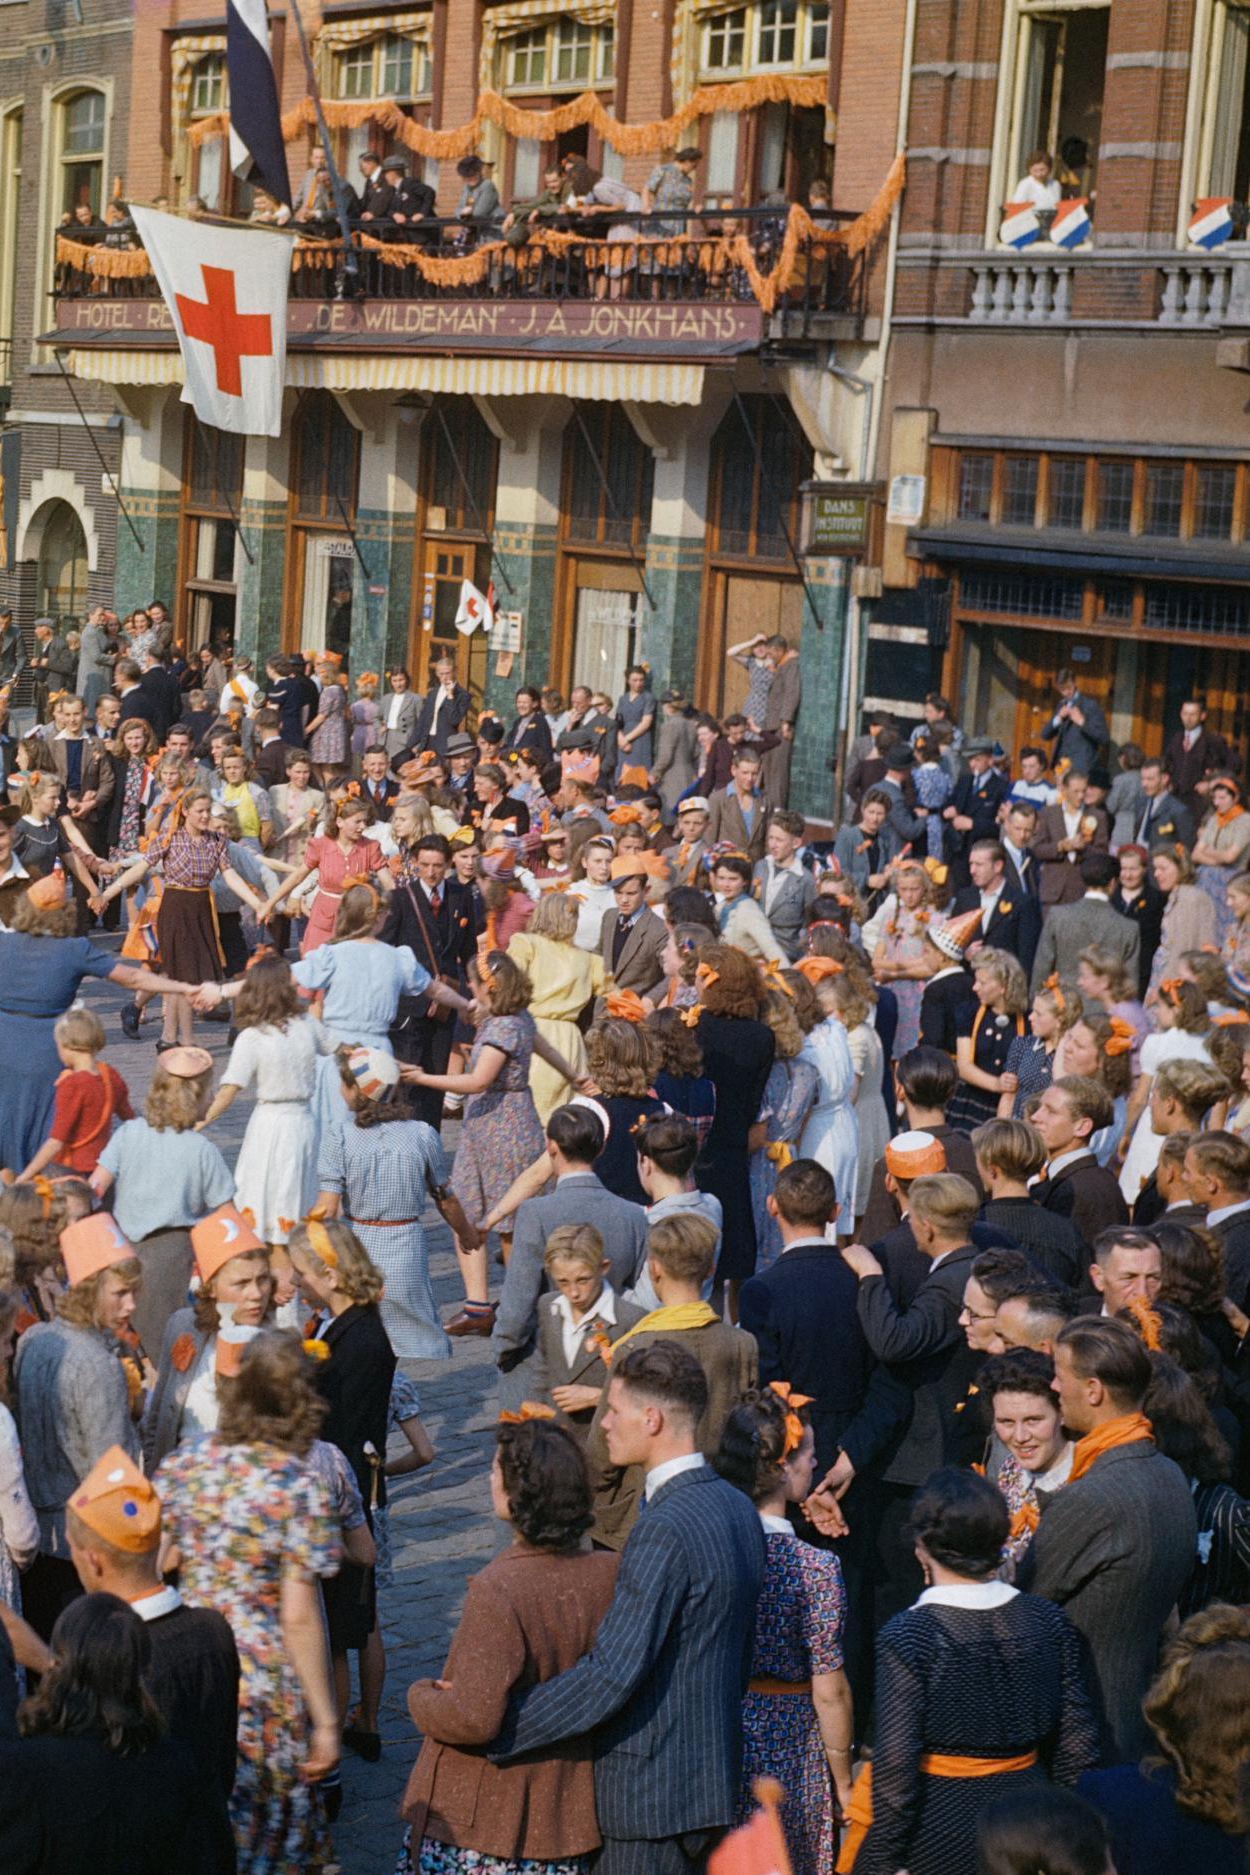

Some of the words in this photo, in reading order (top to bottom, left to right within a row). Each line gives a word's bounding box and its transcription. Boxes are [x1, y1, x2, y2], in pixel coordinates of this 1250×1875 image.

[75, 303, 133, 329] HOTEL
[580, 306, 736, 338] JONKHANS
[824, 499, 855, 514] DANS
